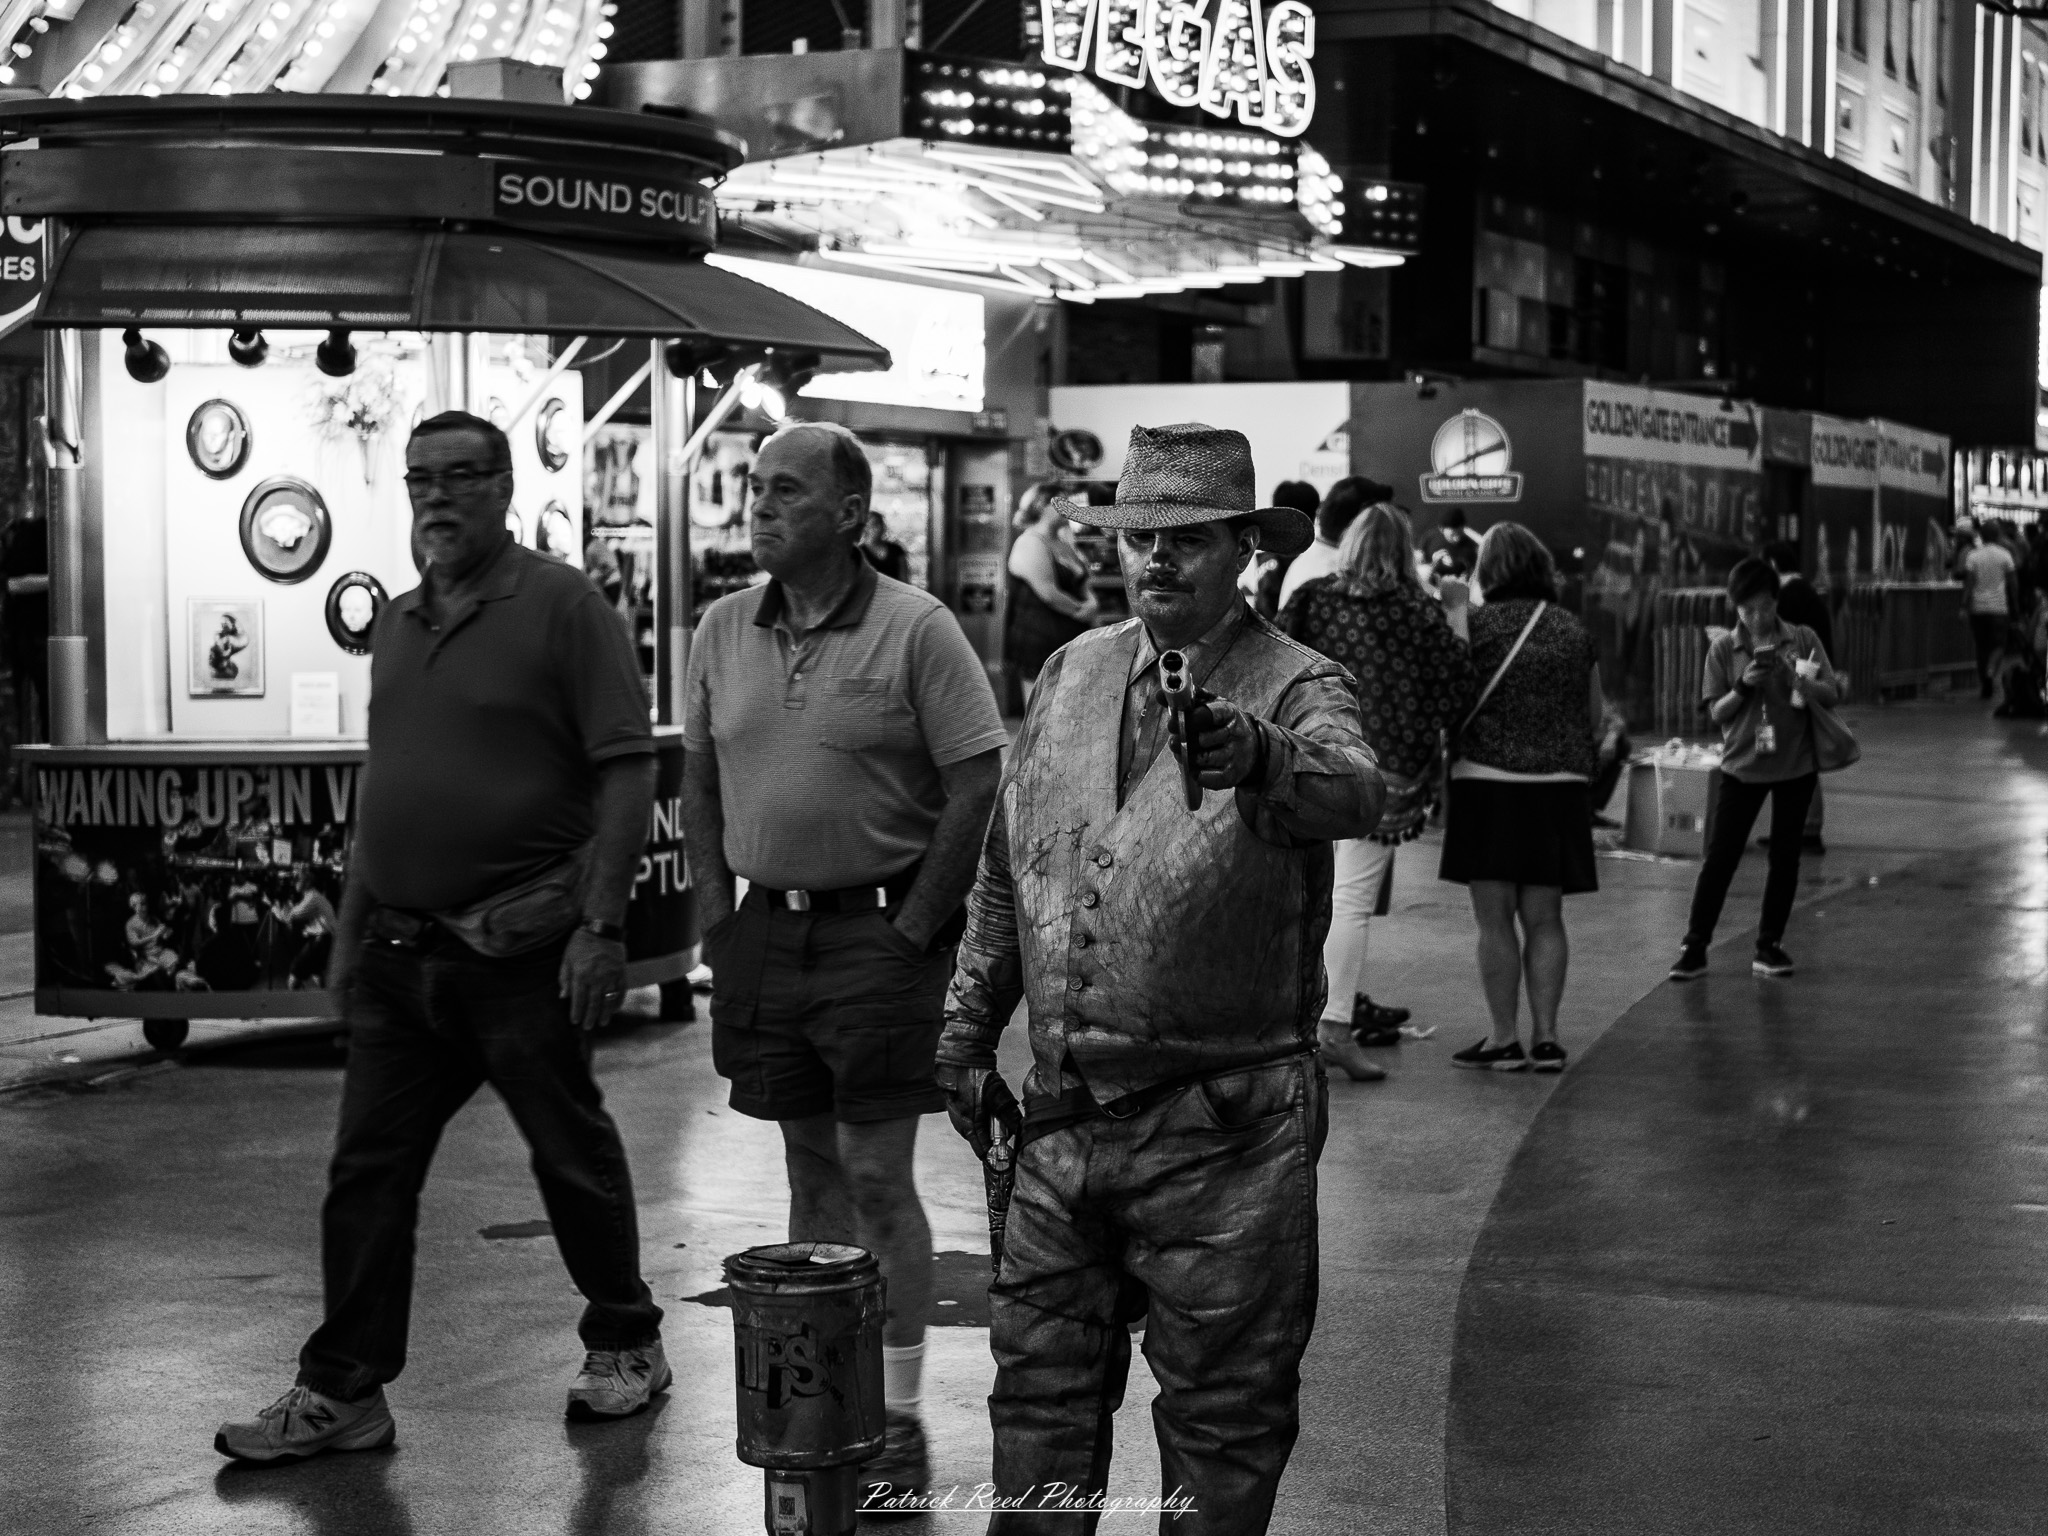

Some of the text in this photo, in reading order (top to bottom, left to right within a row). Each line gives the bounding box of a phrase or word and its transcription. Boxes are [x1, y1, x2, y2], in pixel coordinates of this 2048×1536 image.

[1041, 0, 1315, 137] VEGAS
[500, 173, 632, 214] SOUND
[0, 256, 36, 281] ES
[1587, 400, 1730, 449] GOLDEN GATE ENTRANCE
[1879, 436, 1919, 474] NTRANCE
[1681, 468, 1757, 542] GATE
[39, 767, 353, 827] WAKING UP IN V
[630, 850, 690, 899] PTU
